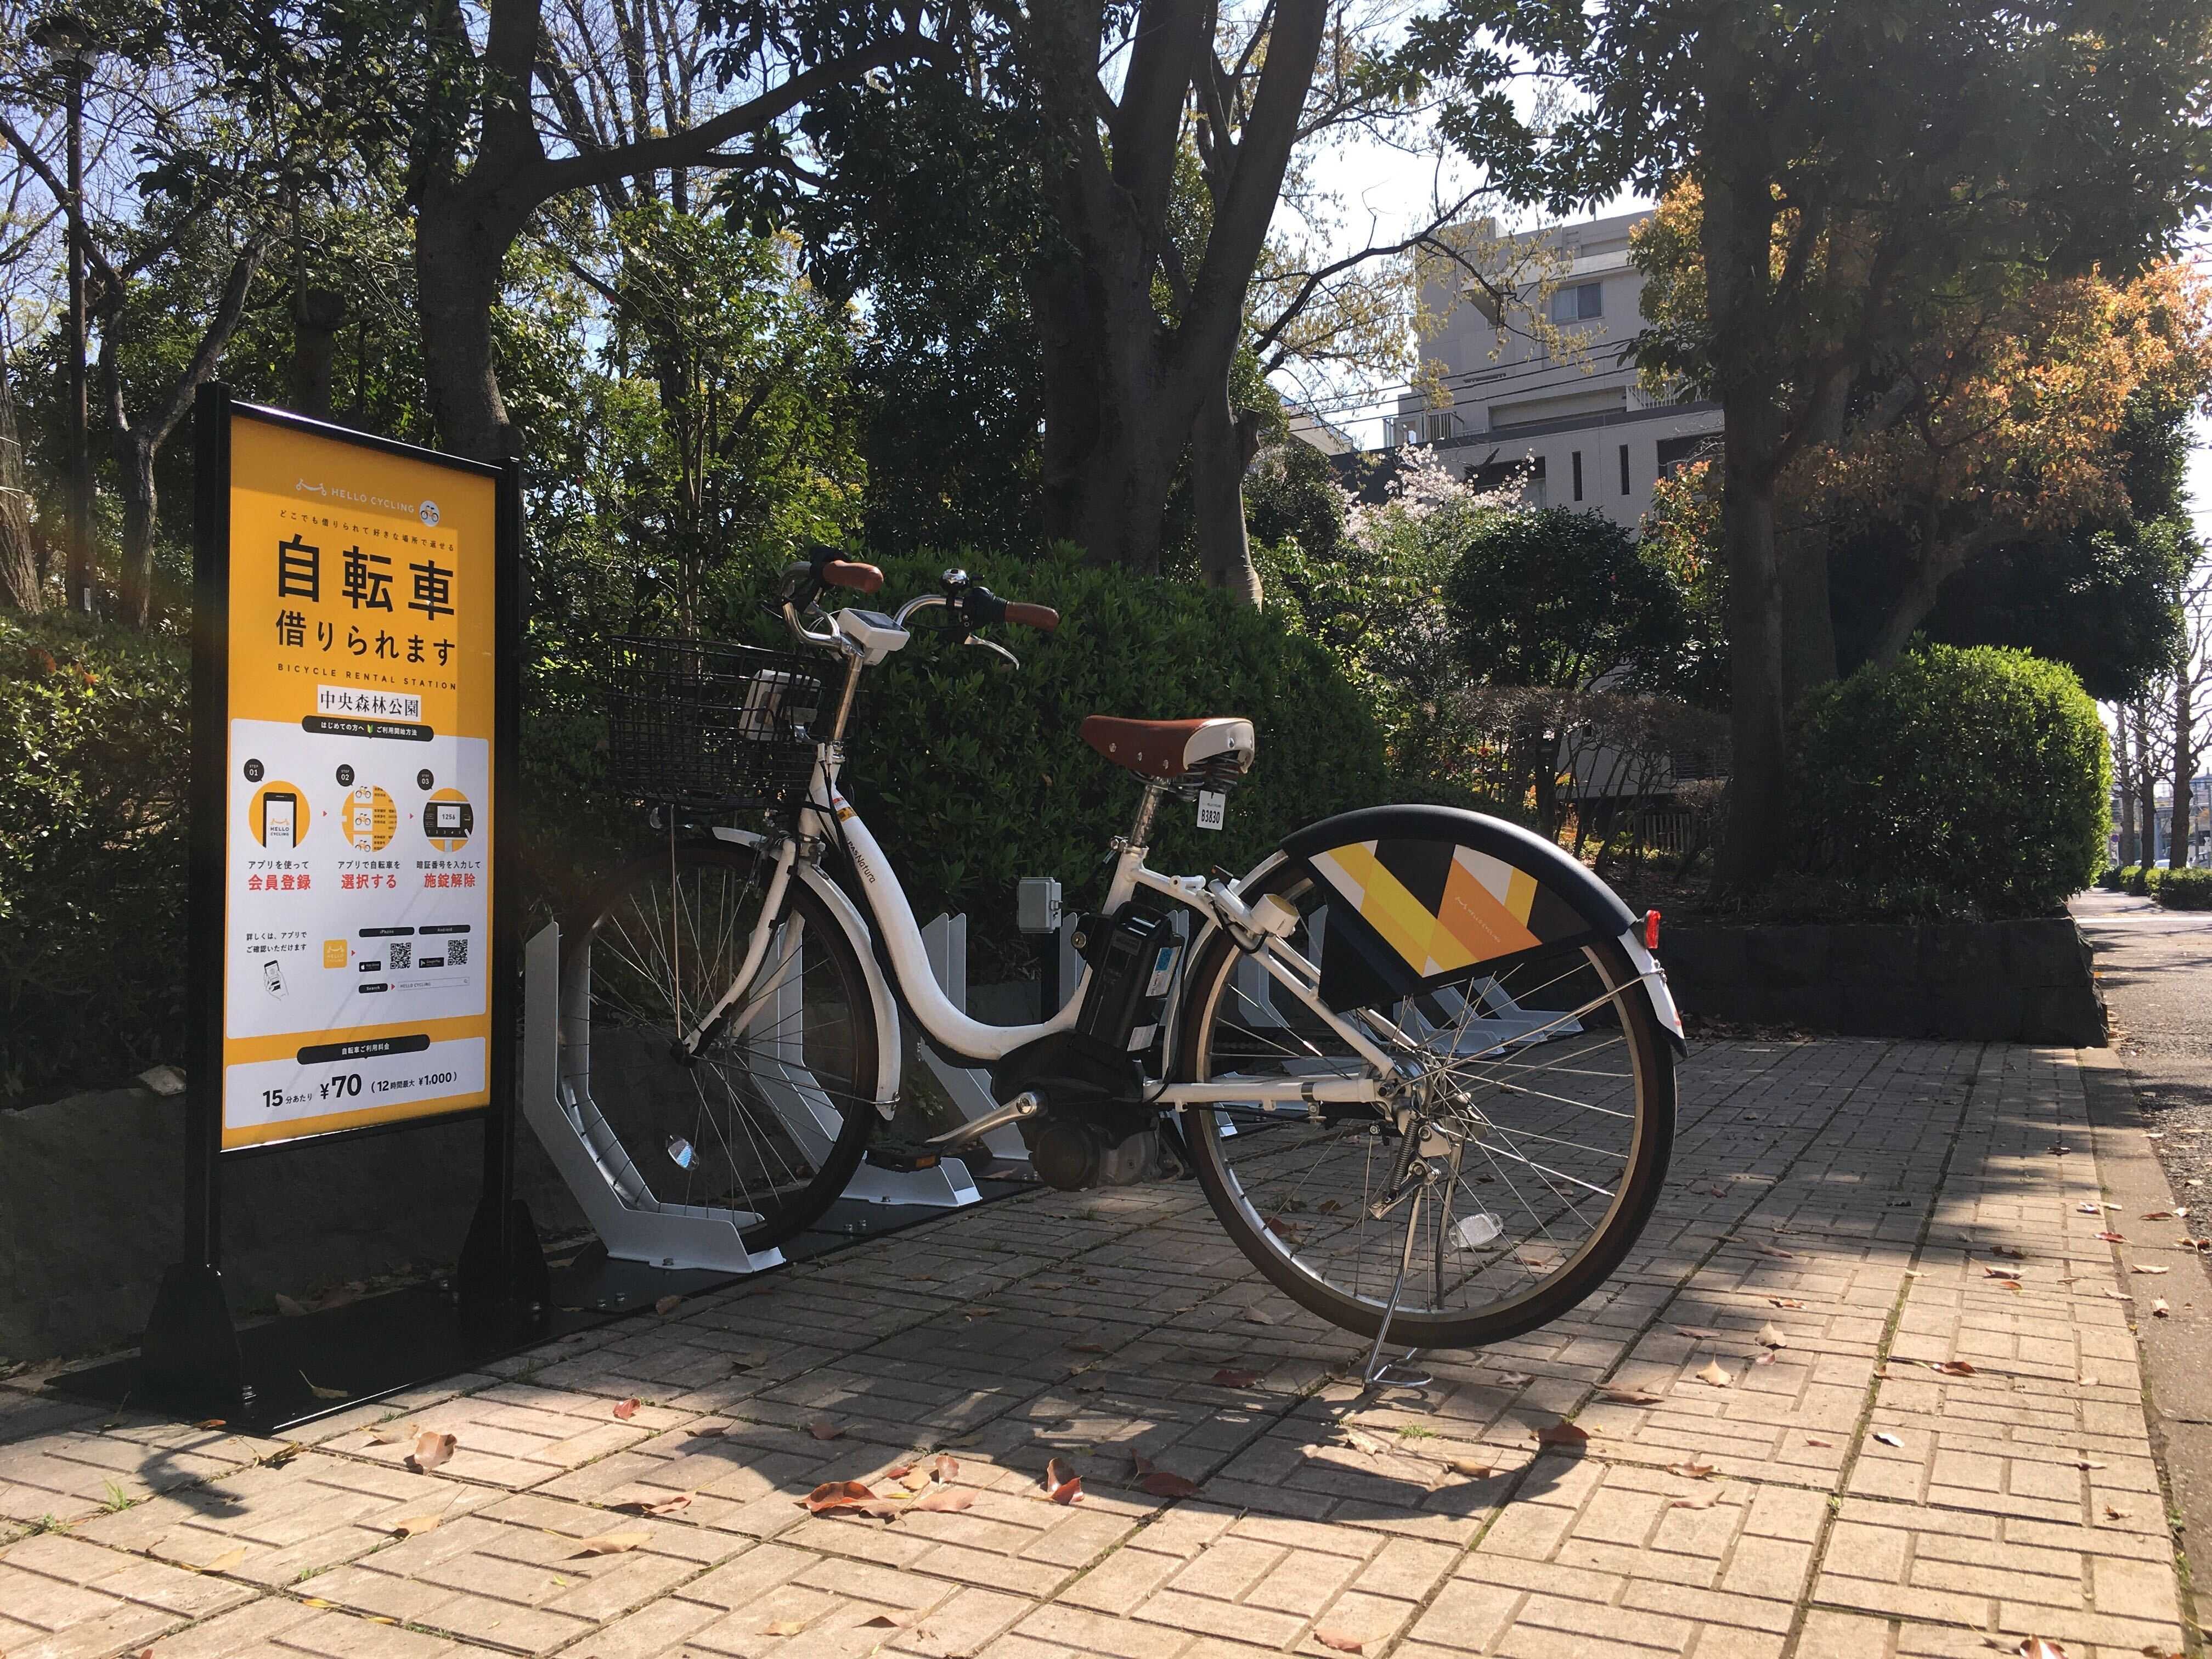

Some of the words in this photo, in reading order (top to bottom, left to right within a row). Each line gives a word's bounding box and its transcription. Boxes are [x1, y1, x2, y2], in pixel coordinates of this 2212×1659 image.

[331, 487, 367, 503] HELLO
[371, 496, 415, 513] CYCLING
[278, 533, 455, 621] 自転車
[275, 609, 455, 667] 借りられます
[278, 663, 336, 676] BICYCLE
[346, 671, 395, 684] RENTAL
[403, 678, 456, 690] STATION
[320, 690, 419, 718] 中央森林公園
[320, 721, 365, 731] はじめての方へ
[376, 726, 417, 736] ご利用開始方法
[1201, 809, 1220, 824] B3830
[248, 860, 309, 870] アプリを使って
[337, 860, 401, 870] アプリで自転車を
[416, 860, 481, 870] 暗証番号を入力して
[855, 855, 876, 884] Natura
[248, 874, 312, 891] 会員登録
[341, 873, 397, 889] 選択する
[424, 873, 476, 888] 施錠解除
[246, 944, 307, 953] ご確認いただけます
[341, 1042, 390, 1056] 自転車ご利用料金
